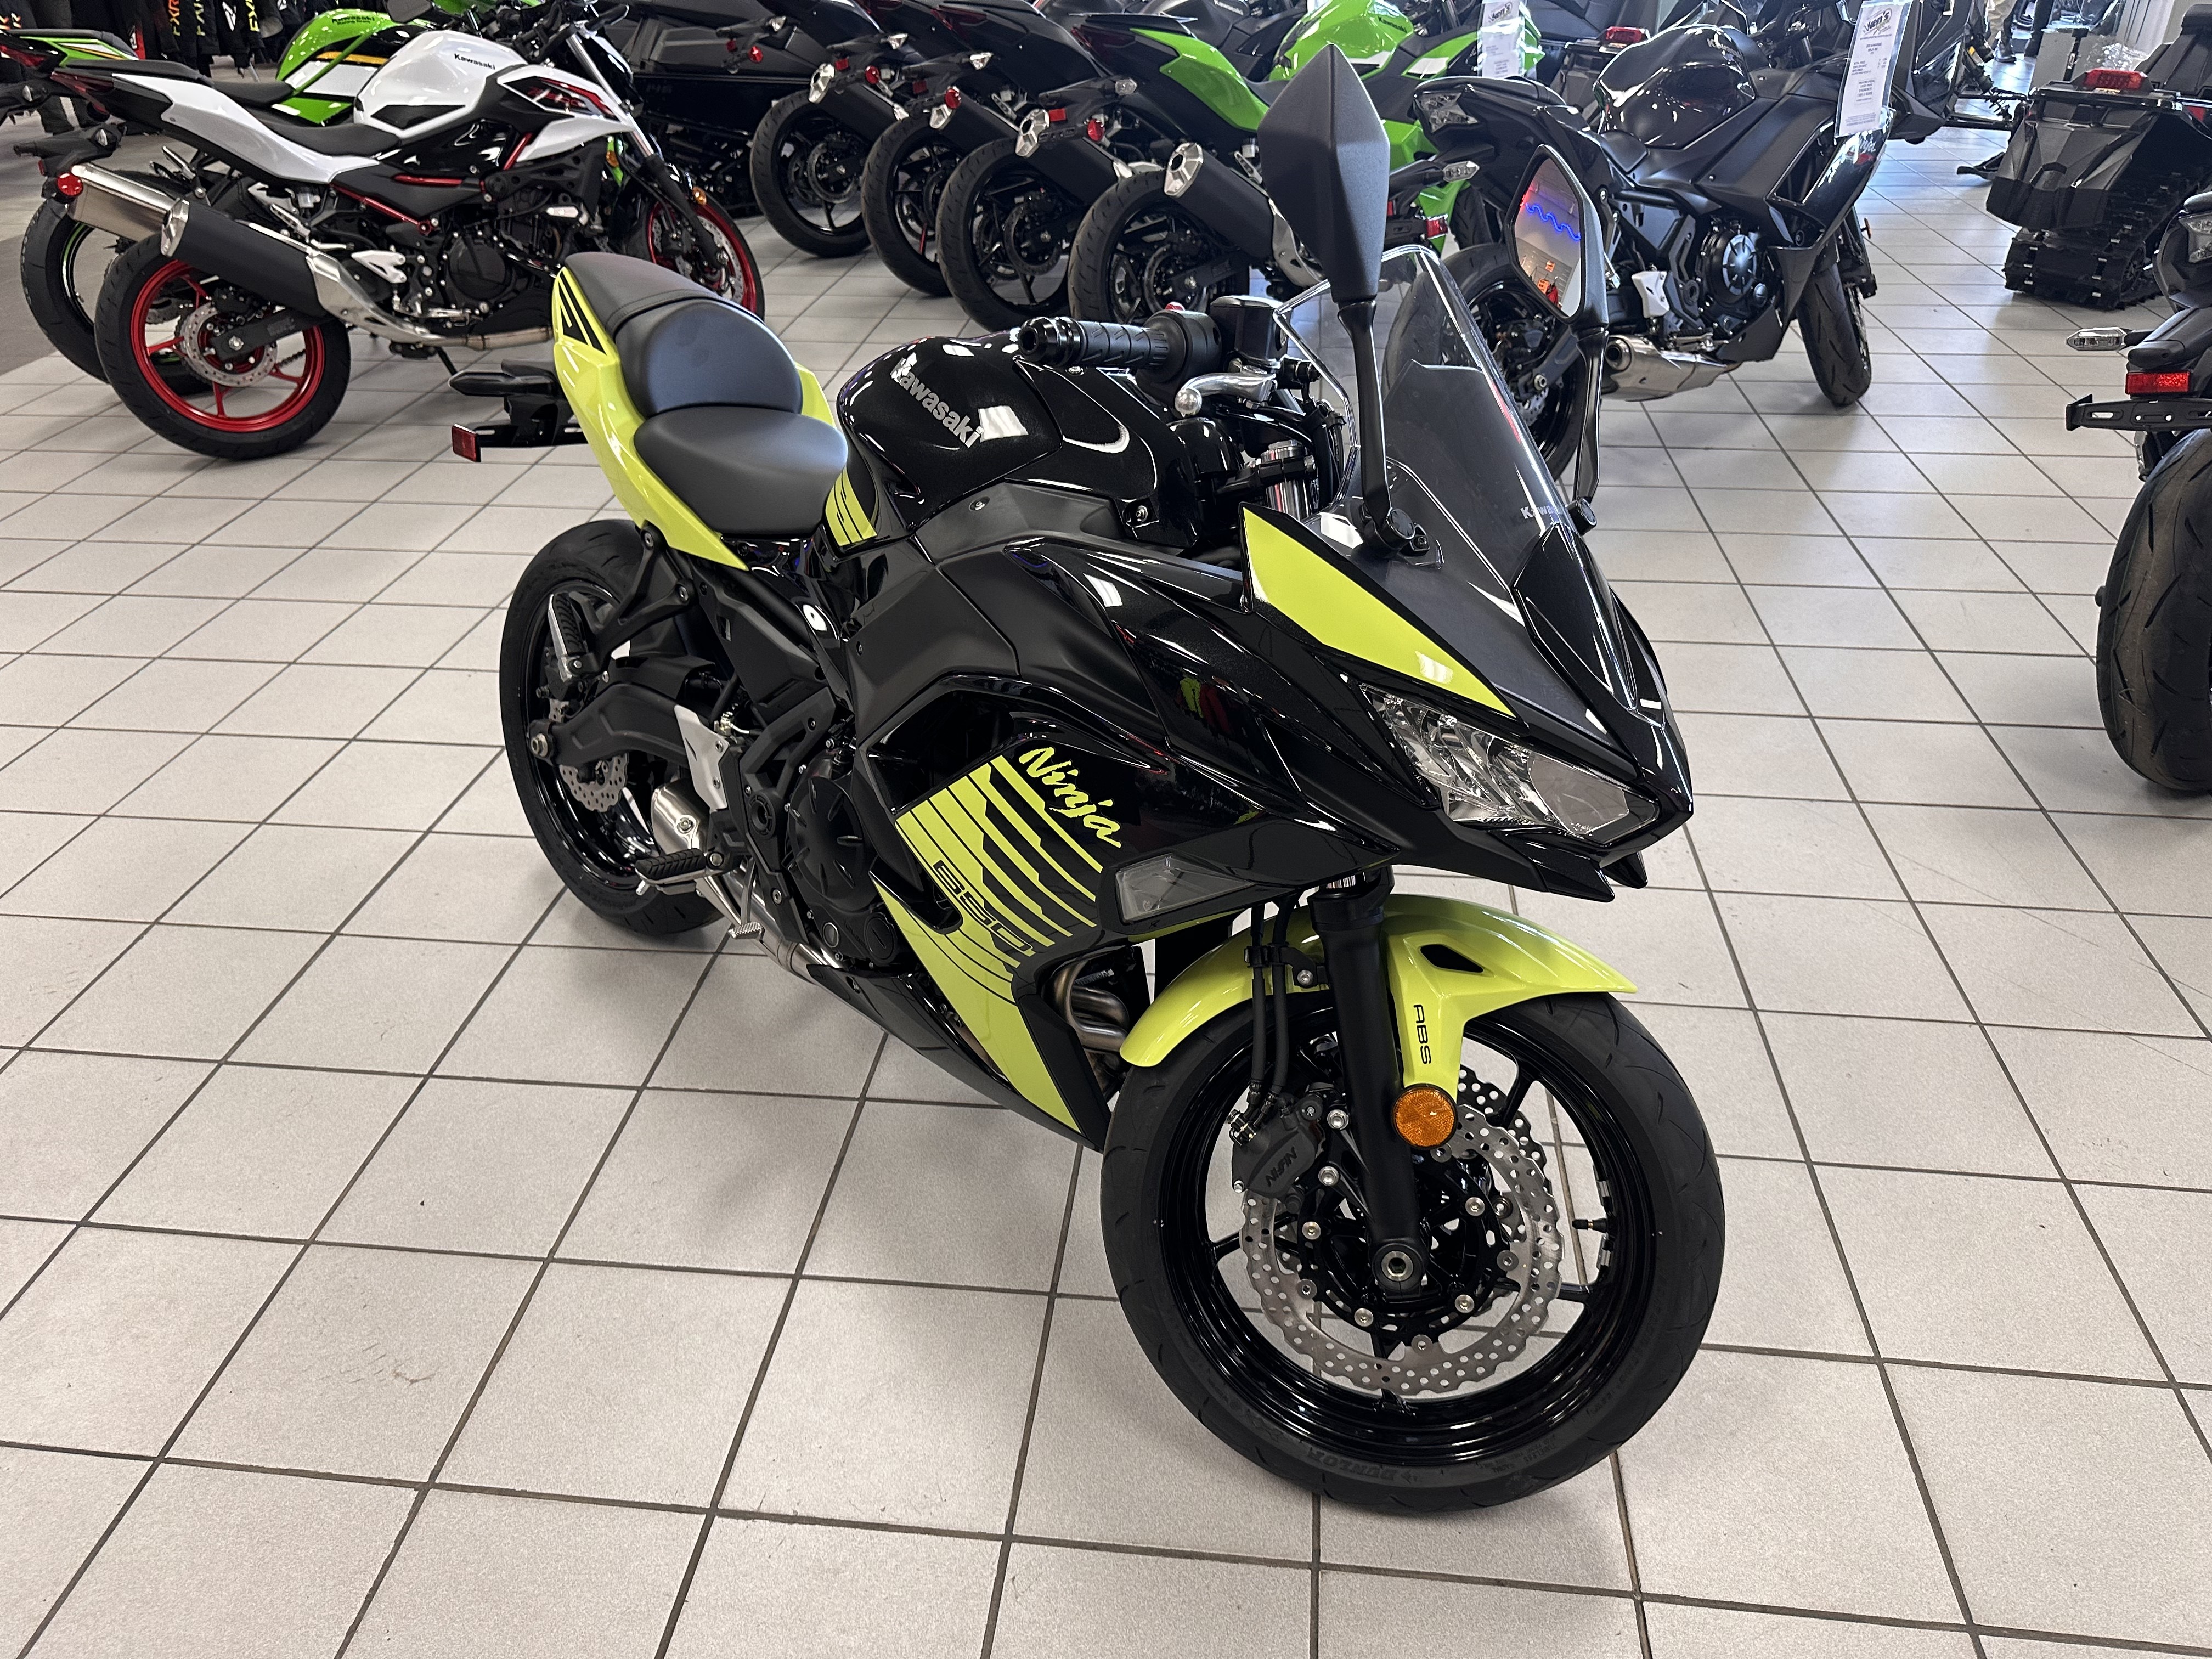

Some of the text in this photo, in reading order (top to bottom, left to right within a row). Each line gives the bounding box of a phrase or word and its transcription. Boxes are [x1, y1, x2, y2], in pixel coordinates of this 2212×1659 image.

[454, 53, 495, 70] Kawasaki
[890, 357, 984, 448] Kawasaki
[1018, 747, 1122, 849] Ninja
[933, 860, 1032, 952] 650
[1413, 1004, 1431, 1064] ABS
